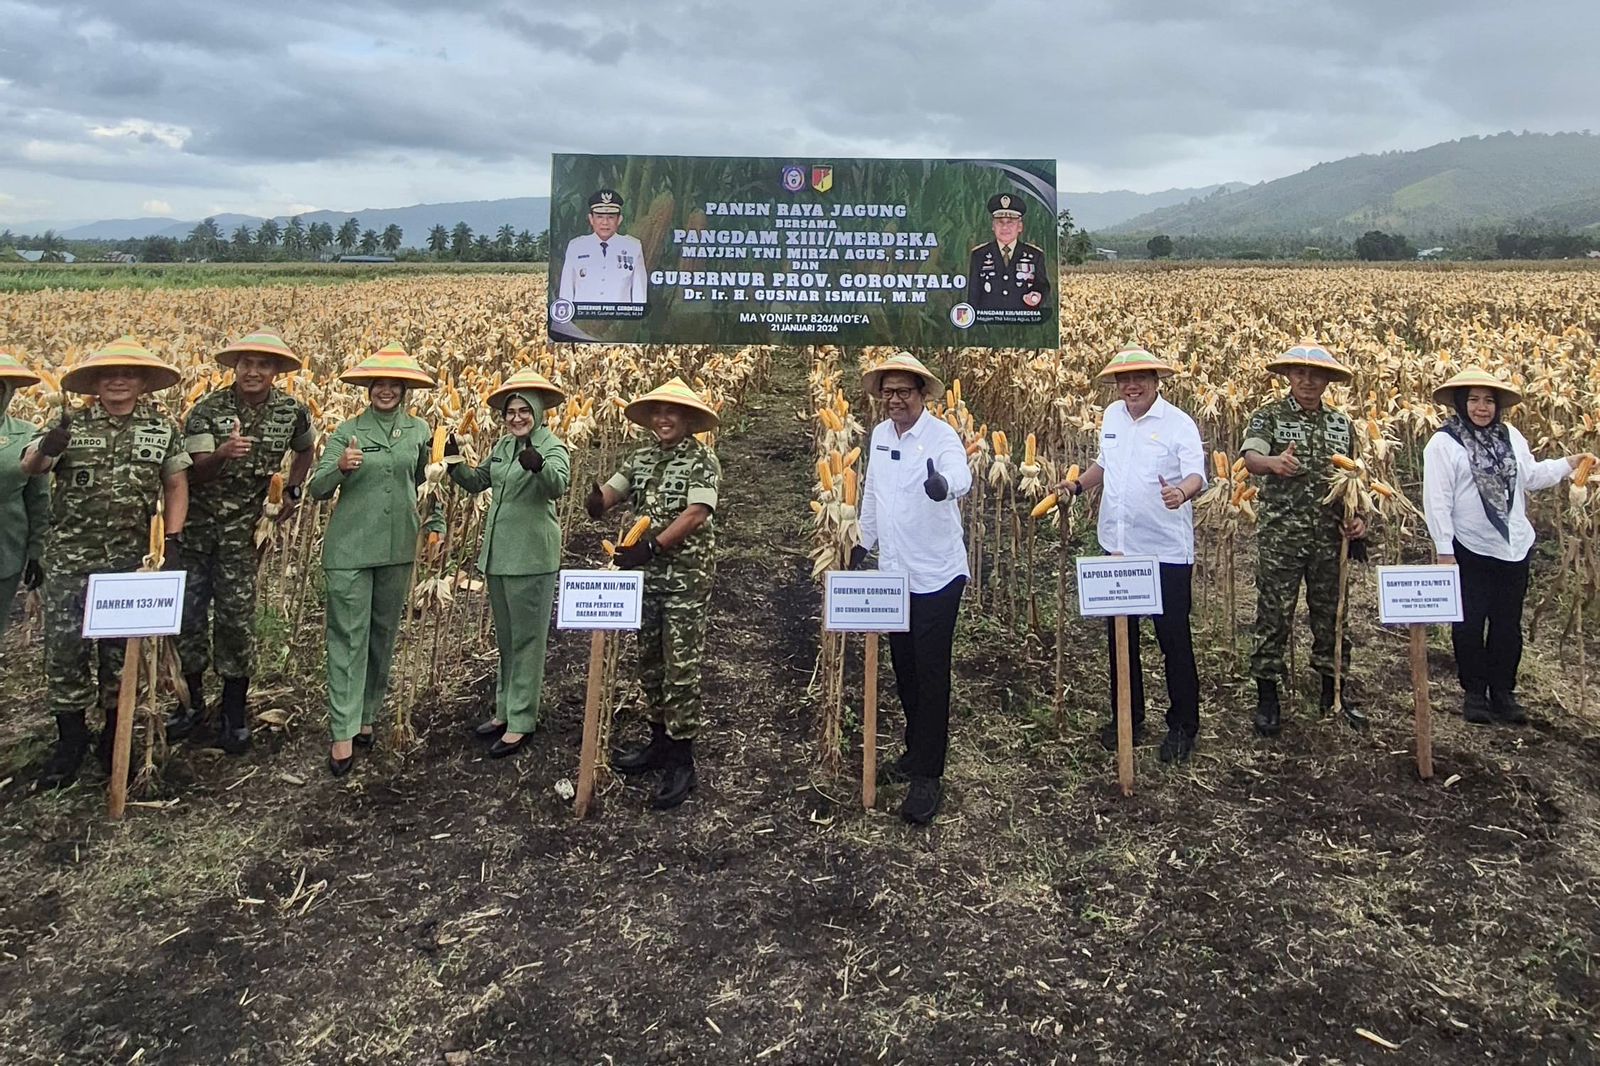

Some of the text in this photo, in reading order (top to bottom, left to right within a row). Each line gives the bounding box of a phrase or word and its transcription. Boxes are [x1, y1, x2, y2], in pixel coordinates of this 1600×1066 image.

[705, 202, 907, 218] PANEN RAYA JAGUNG
[775, 219, 837, 229] BERSAMA
[673, 229, 938, 247] PANGDAM XIII/MERDEKA
[682, 246, 930, 262] MAYJEN TNI MIRZA AGUS, S.I.P
[792, 261, 819, 270] DAN
[650, 271, 967, 289] GUBERNUR PROV. GORONTALO
[684, 288, 926, 303] Dr. Ir. H. GUSNAR ISMAIL, M.M
[739, 313, 758, 322] MA
[759, 313, 793, 323] YONIF
[795, 313, 808, 323] TP
[770, 324, 839, 332] 21 JANUARI 2026
[1082, 568, 1152, 579] KAPOLDA GORONTALO
[566, 581, 602, 591] PANGDAM
[833, 587, 901, 595] GUBERNUR GORONTALO
[95, 597, 174, 610] DANREM 133/NW
